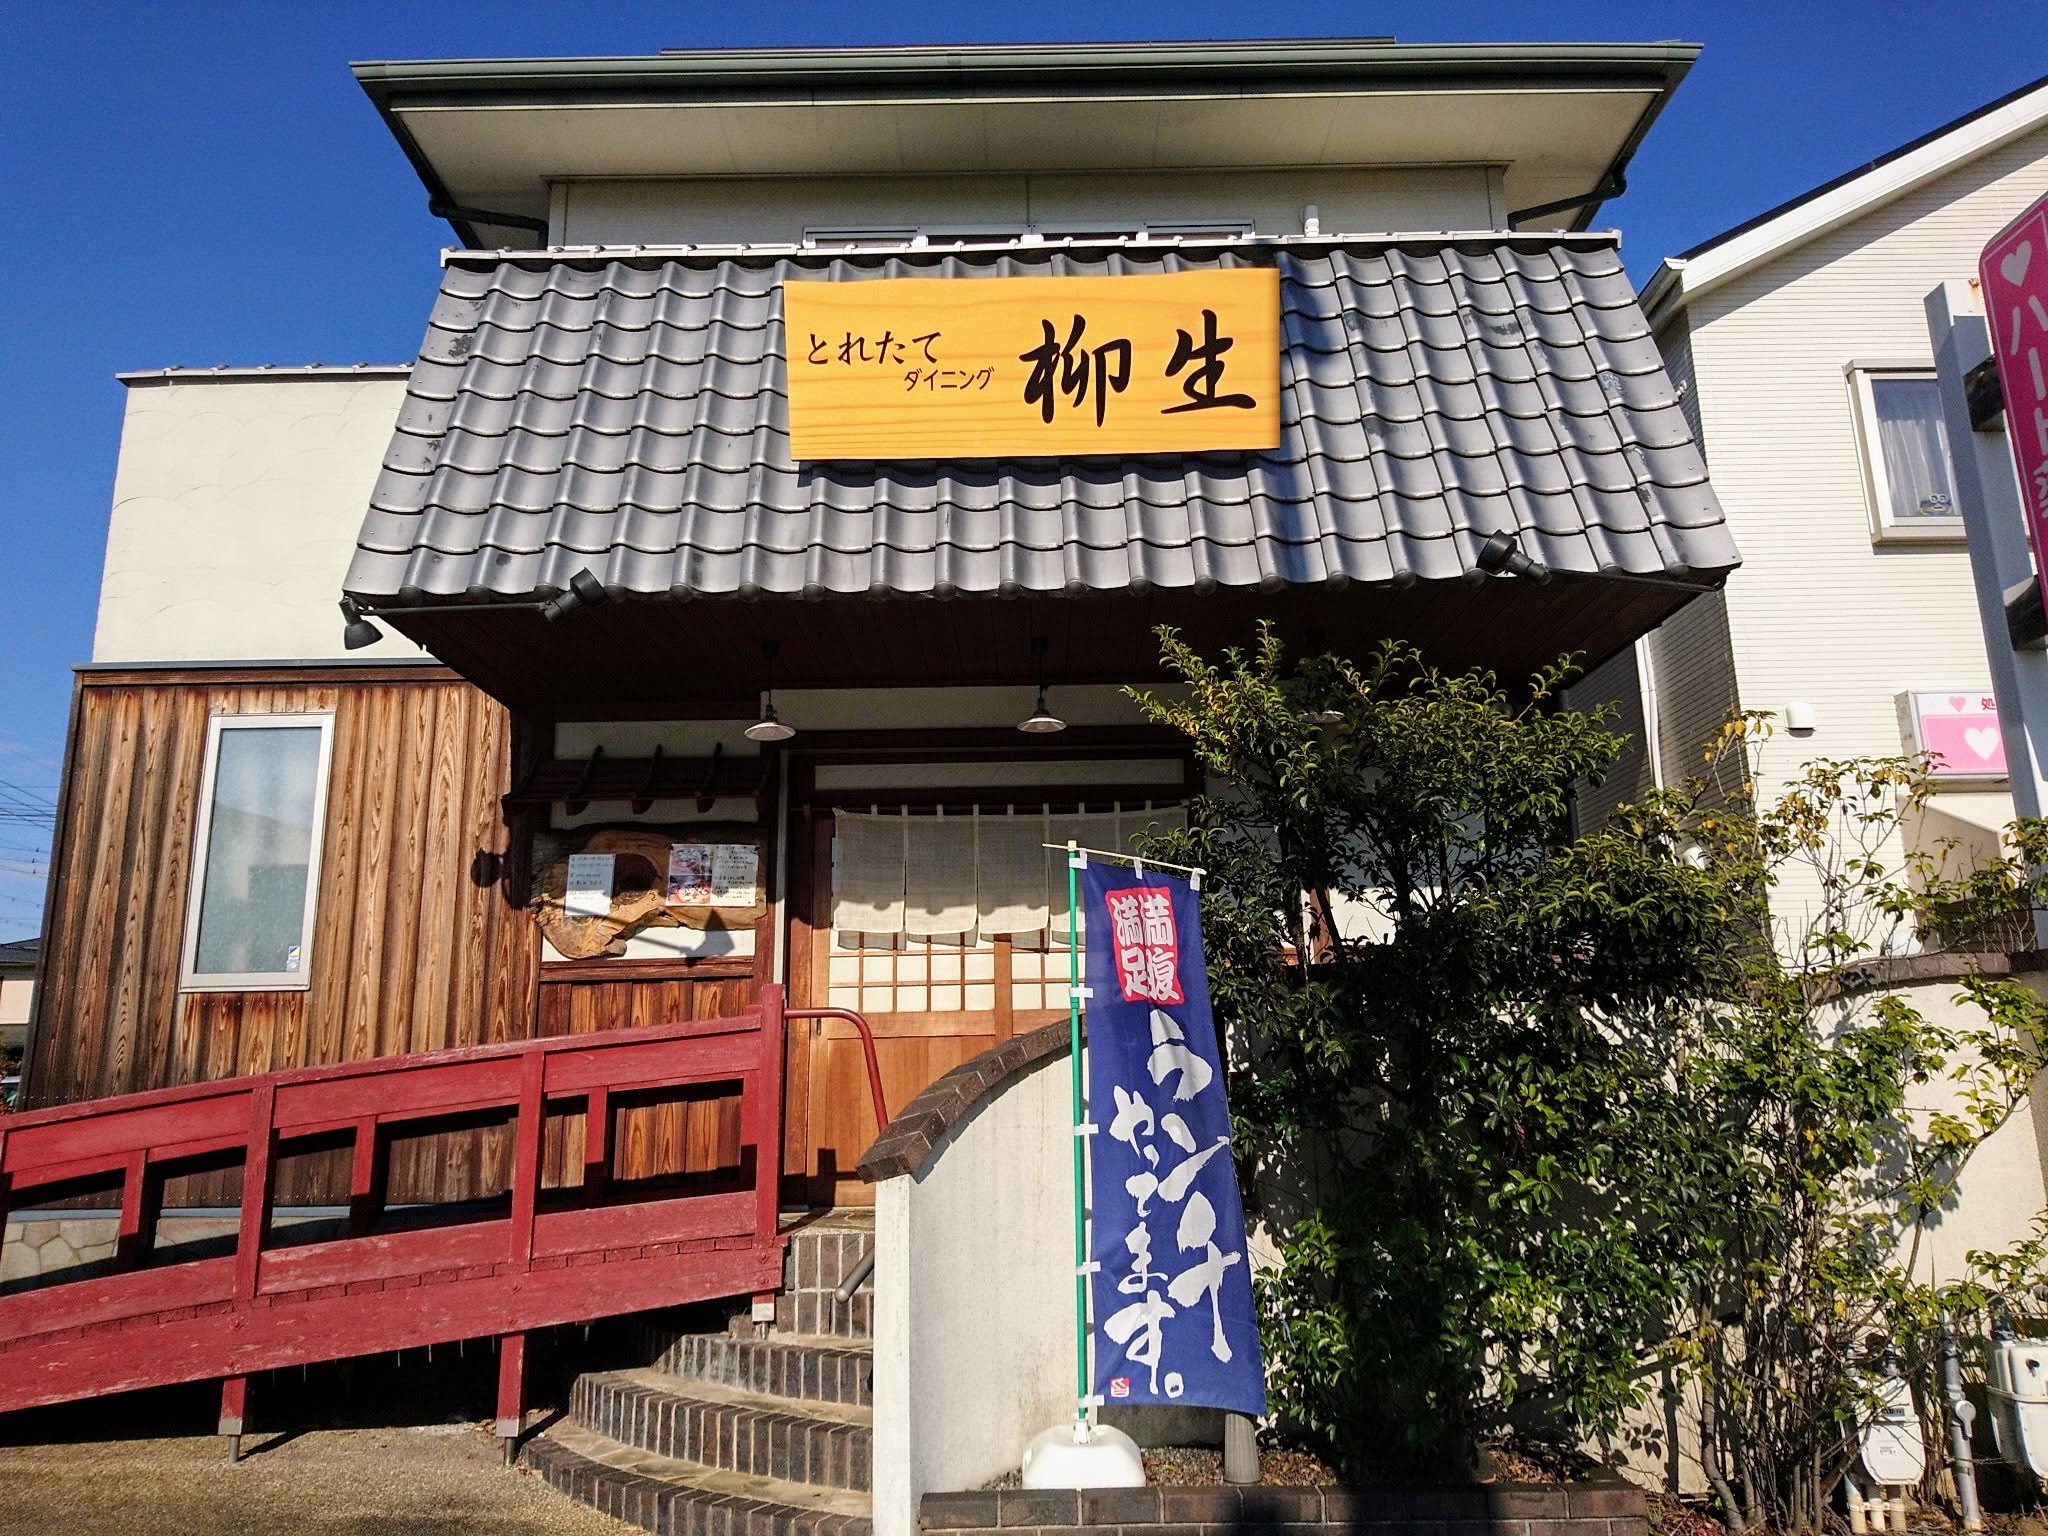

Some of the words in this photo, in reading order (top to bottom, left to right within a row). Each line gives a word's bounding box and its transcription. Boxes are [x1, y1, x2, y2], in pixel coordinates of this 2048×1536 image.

[807, 330, 942, 365] とれたて
[904, 367, 995, 392] ダイニング
[1018, 309, 1257, 427] 柳生
[2010, 294, 2048, 518] ハート
[1109, 895, 1150, 998] 満足
[1139, 894, 1180, 1001] 満腹
[1147, 1008, 1241, 1363] ランチ
